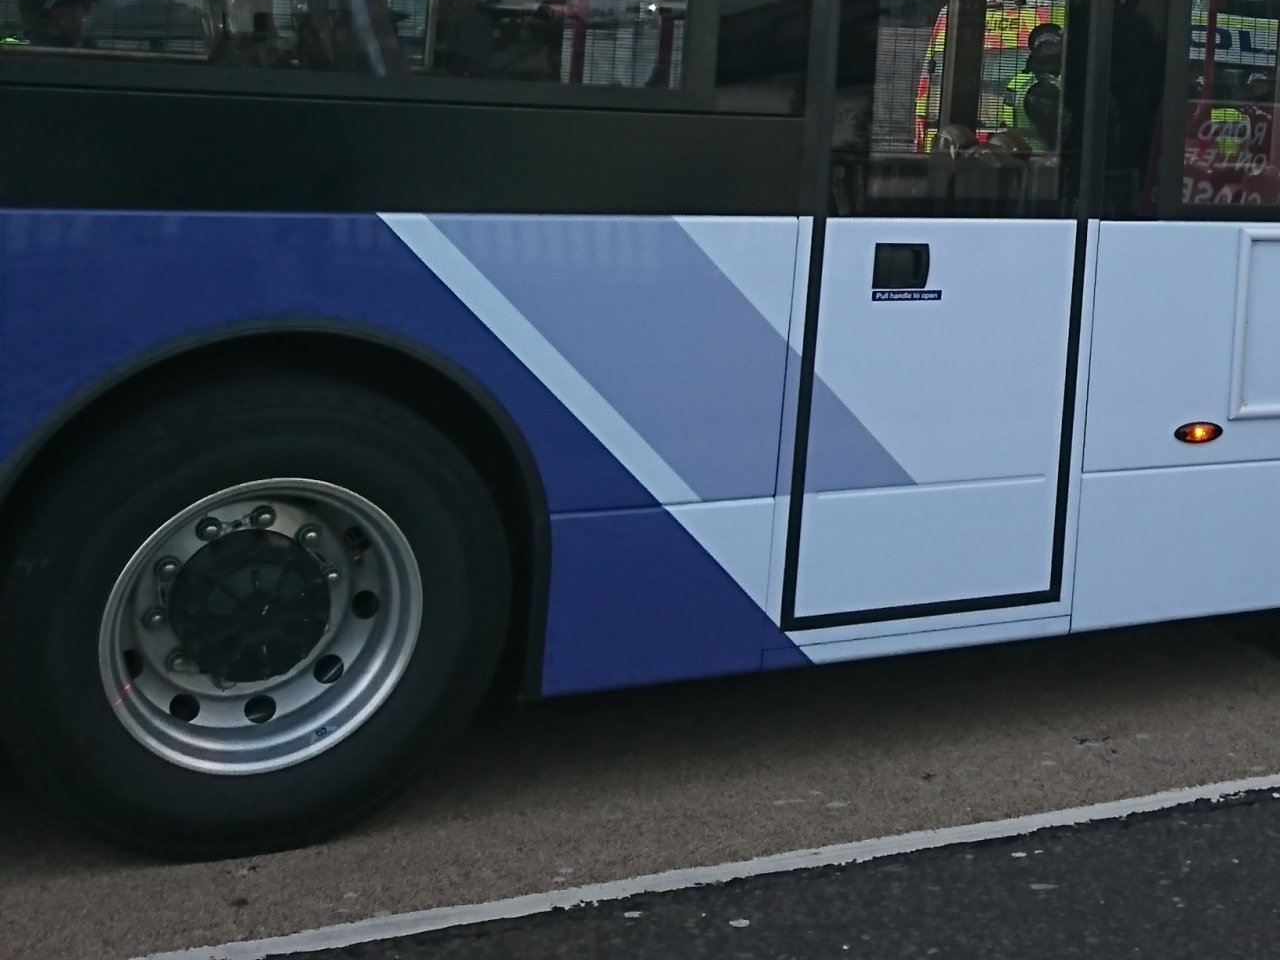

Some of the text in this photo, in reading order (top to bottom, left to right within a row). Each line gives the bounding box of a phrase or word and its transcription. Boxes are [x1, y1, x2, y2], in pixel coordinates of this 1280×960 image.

[875, 292, 889, 300] Pull
[890, 292, 912, 300] handle
[921, 292, 938, 300] open
